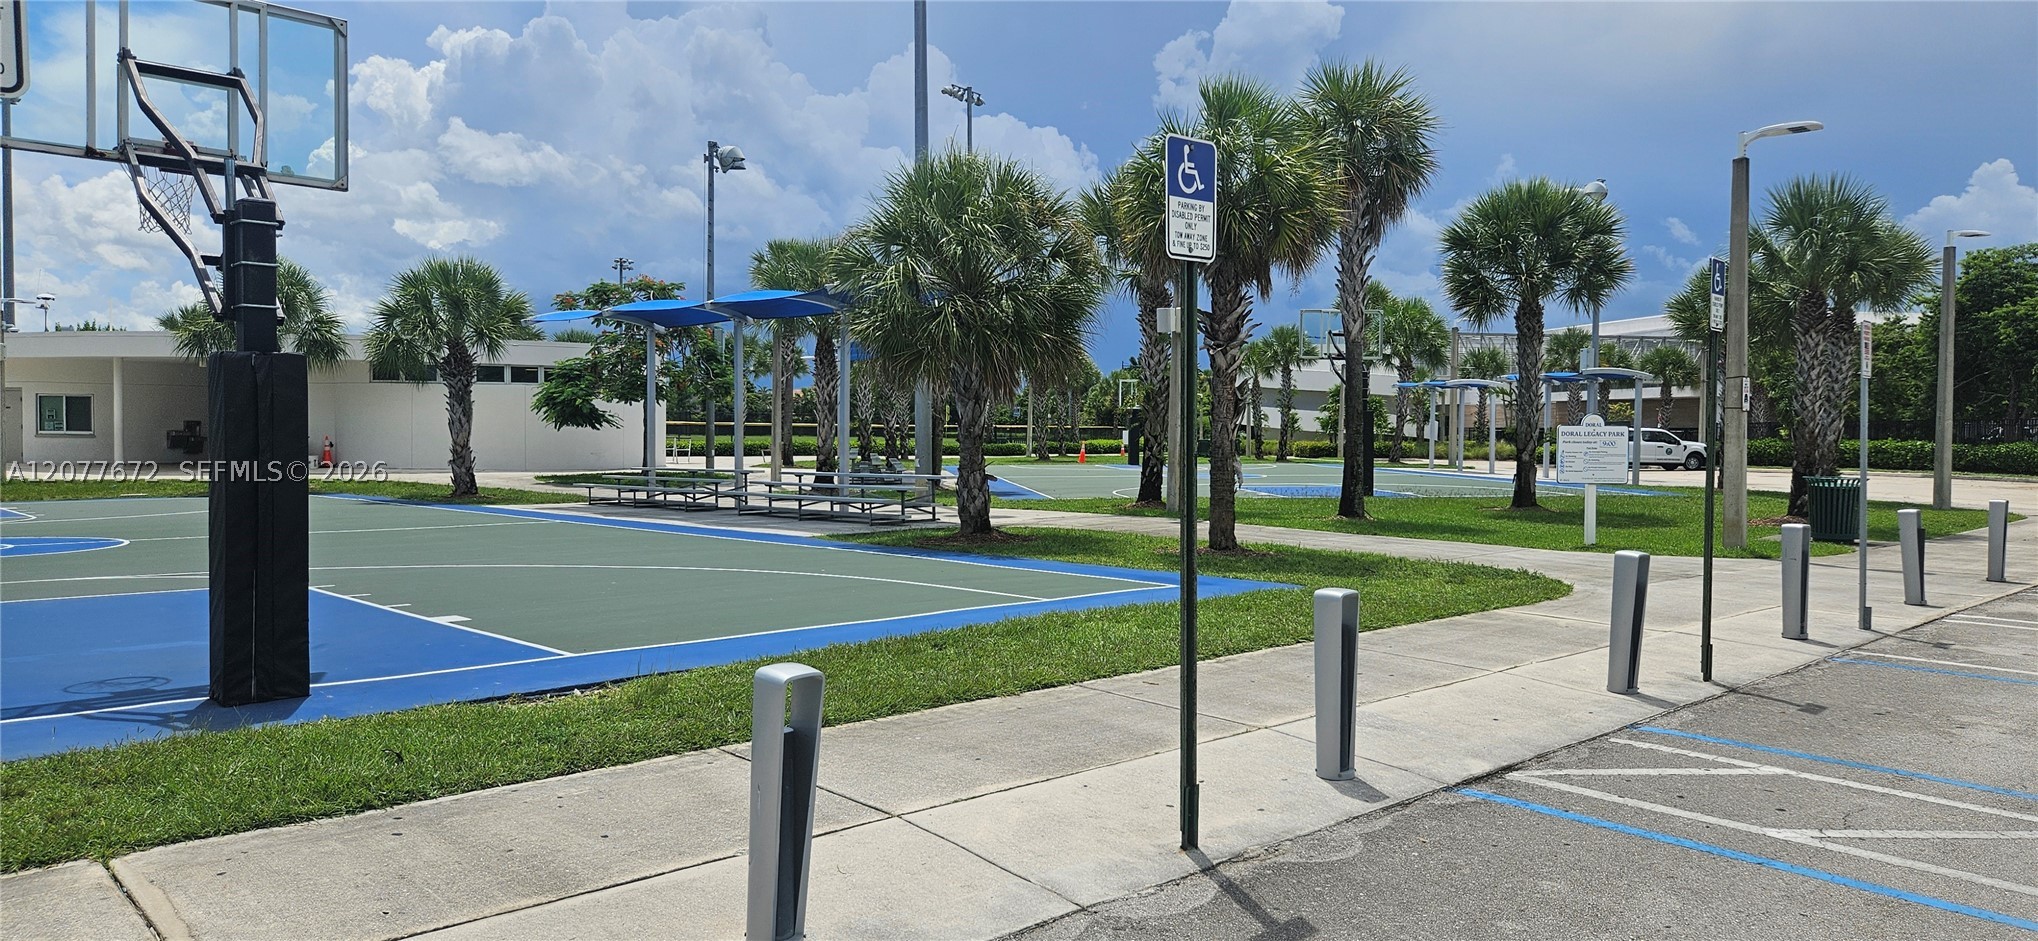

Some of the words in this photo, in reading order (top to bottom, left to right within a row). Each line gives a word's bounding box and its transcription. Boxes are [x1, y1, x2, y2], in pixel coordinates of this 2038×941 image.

[1178, 201, 1198, 211] PARKING
[1172, 210, 1193, 220] DISABLED
[1194, 213, 1210, 222] PERMIT
[1185, 222, 1197, 230] ONLY
[1175, 231, 1183, 239] TOW
[1197, 234, 1207, 242] ZONE
